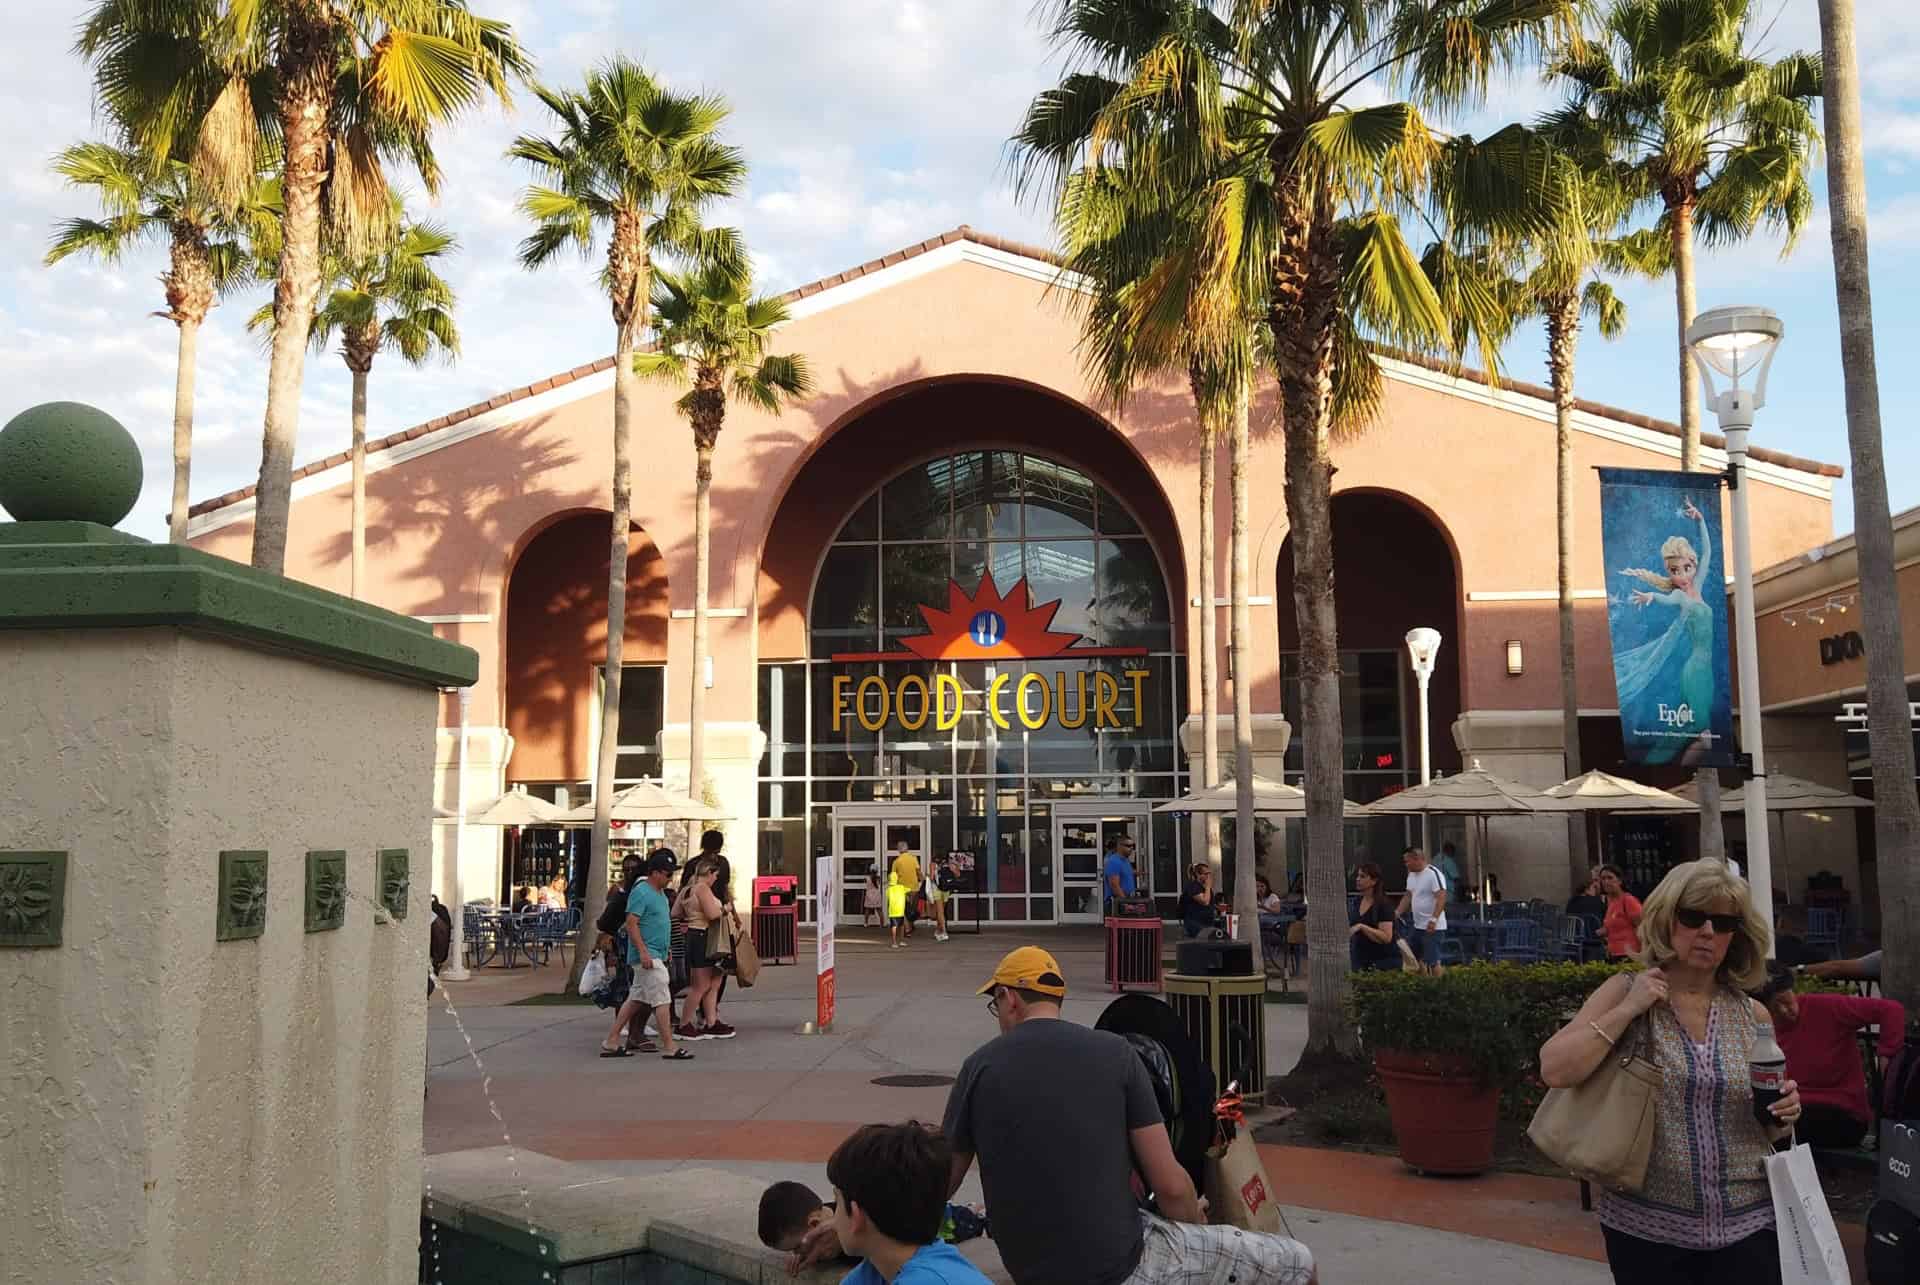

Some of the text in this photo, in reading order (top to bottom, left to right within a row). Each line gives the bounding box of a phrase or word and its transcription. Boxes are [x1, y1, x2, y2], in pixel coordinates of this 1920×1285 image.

[1820, 631, 1865, 665] DKN
[832, 670, 1150, 731] FOOD COURT
[1888, 1156, 1911, 1179] ecco
